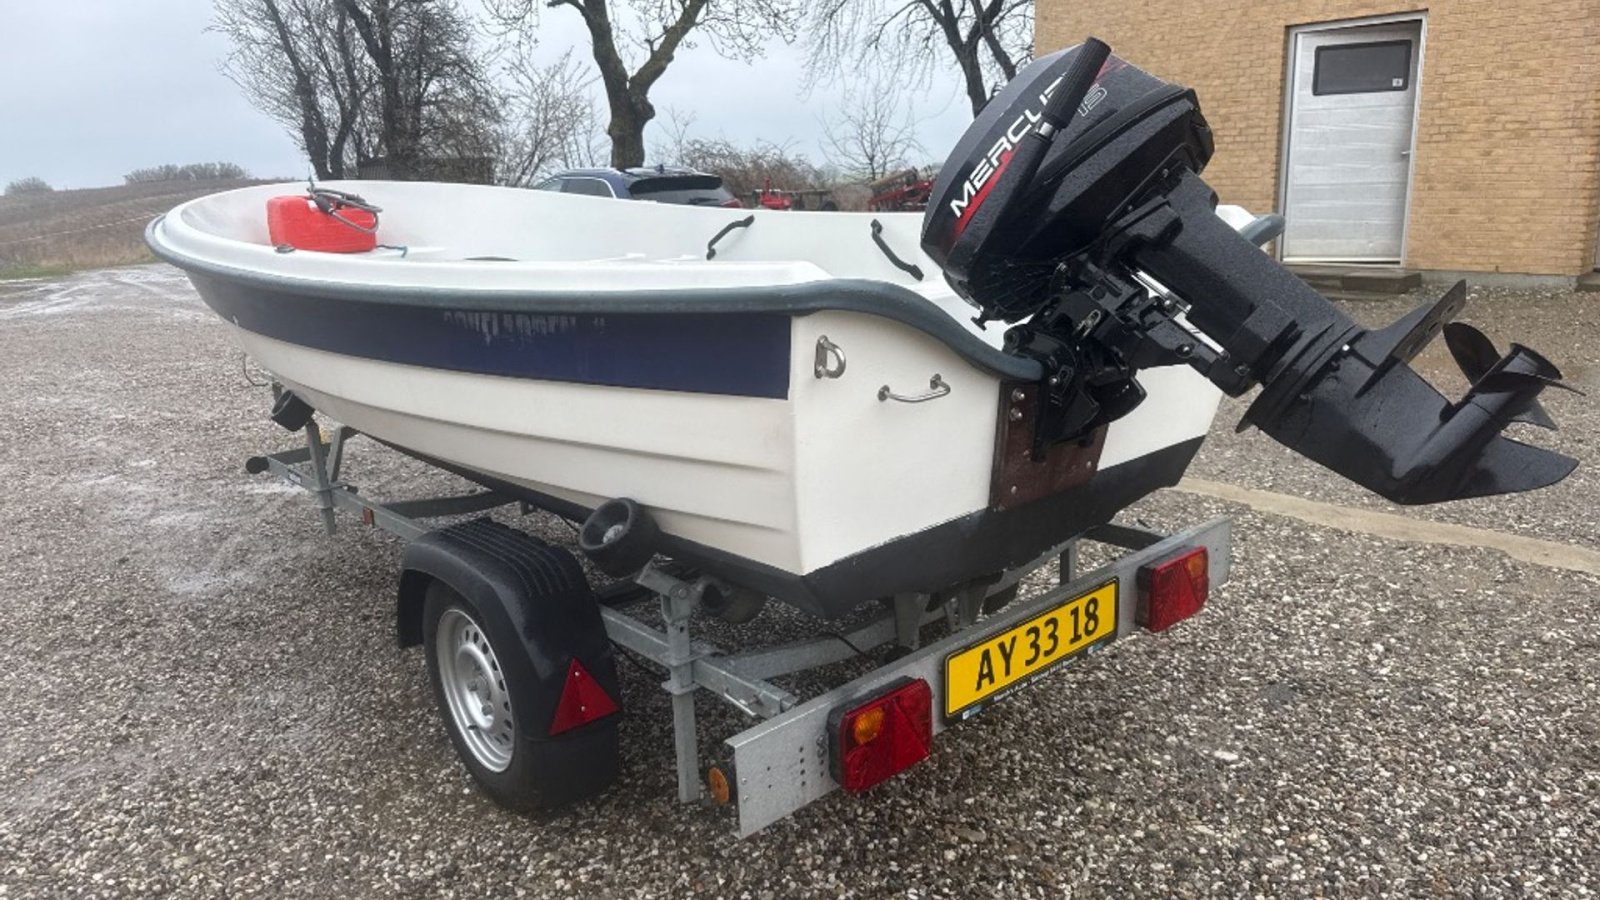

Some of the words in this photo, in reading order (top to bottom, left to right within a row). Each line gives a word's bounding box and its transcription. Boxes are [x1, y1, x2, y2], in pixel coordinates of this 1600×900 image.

[950, 72, 1068, 218] MERCU
[1078, 83, 1107, 117] 15
[976, 636, 1017, 691] AY
[1025, 617, 1059, 667] 33
[1069, 597, 1099, 645] 18
